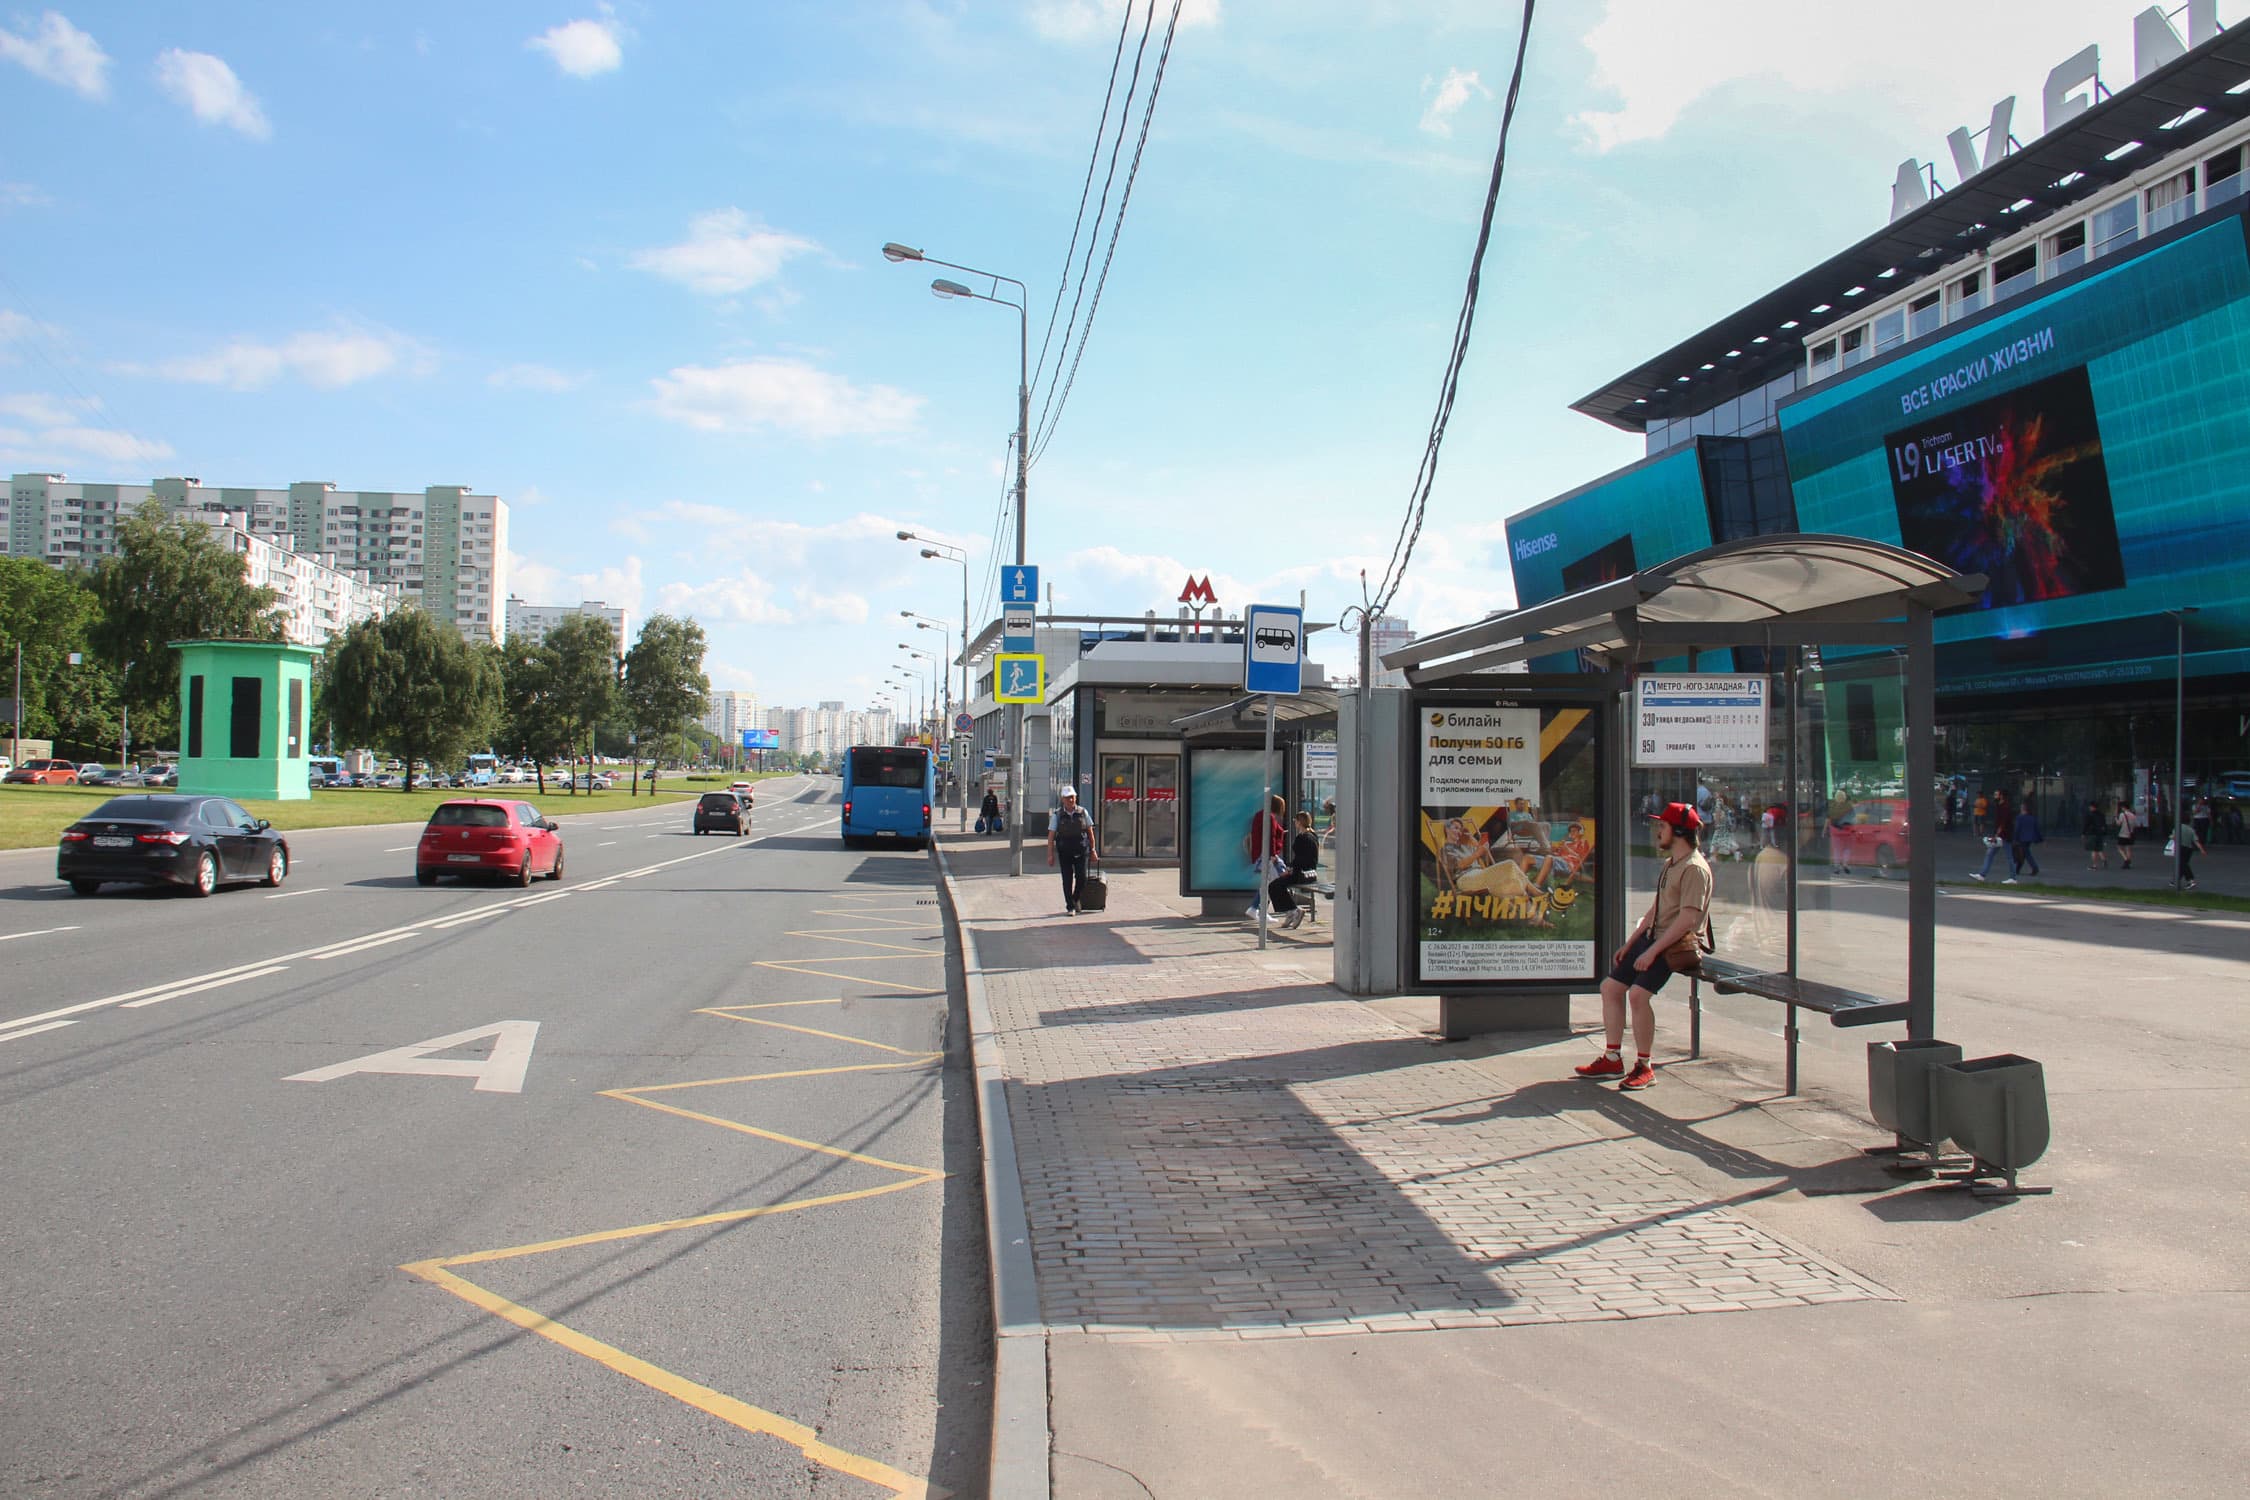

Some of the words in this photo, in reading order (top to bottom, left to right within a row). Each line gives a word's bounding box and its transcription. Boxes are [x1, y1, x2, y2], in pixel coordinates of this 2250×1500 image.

[1901, 385, 1929, 415] ВСЕ
[1930, 358, 1988, 400] КРАСКИ
[1989, 326, 2055, 373] ЖИЗНИ
[1894, 442, 1920, 483] L9
[1515, 532, 1558, 561] Hisense
[1656, 682, 1682, 691] МЕТРО
[1683, 682, 1746, 691] «ЮГО-ЗАПАДНАЯ»
[1448, 713, 1501, 727] билайн
[1643, 712, 1655, 727] 330
[1429, 736, 1482, 751] Получи
[1486, 736, 1503, 749] 50
[1507, 736, 1524, 749] Гб
[1642, 739, 1655, 753] 950
[1429, 755, 1454, 767] для
[1458, 755, 1502, 765] семьи
[1429, 776, 1469, 785] Подключи
[1500, 778, 1523, 786] пчелу
[1485, 785, 1514, 793] билайн
[1427, 927, 1443, 936] 12+
